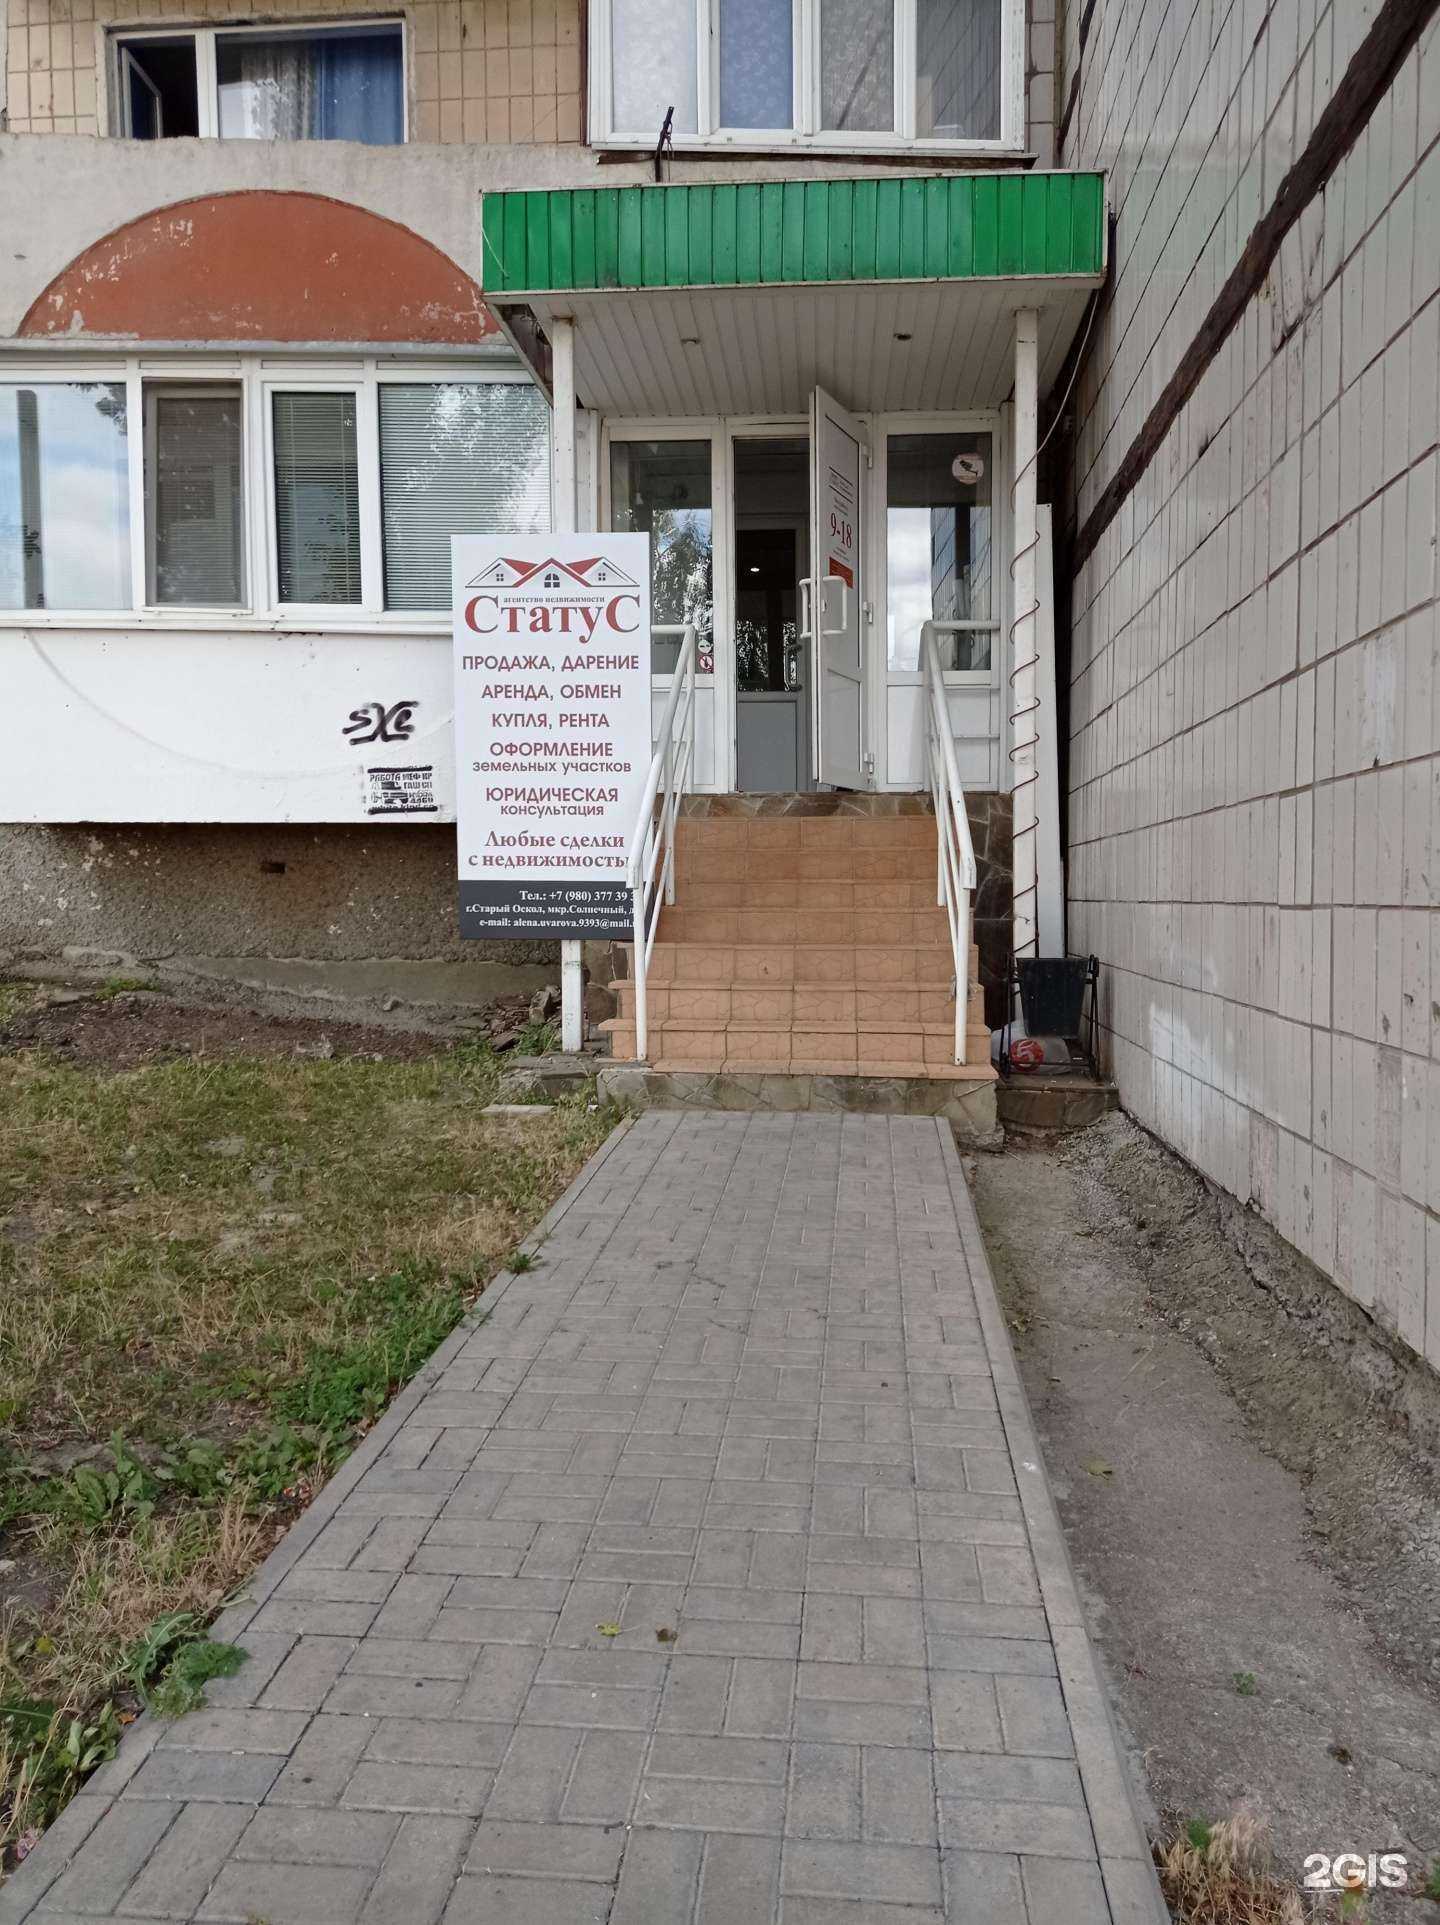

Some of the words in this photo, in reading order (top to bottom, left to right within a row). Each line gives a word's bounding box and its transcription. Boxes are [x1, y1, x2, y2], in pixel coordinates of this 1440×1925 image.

[830, 512, 852, 549] 9-18
[464, 594, 640, 644] СтатуС
[462, 656, 555, 671] ПРОДАЖА,
[561, 656, 639, 671] ДАРЕНИЕ
[481, 685, 554, 701] АРЕНДА,
[560, 684, 621, 699] ОБМЕН
[491, 713, 552, 730] КУПЛЯ,
[559, 713, 610, 727] РЕНТА
[489, 742, 613, 757] ОФОРМЛЕНИЕ
[472, 760, 556, 773] земельных
[562, 761, 632, 775] участков
[369, 773, 401, 782] РАБОТА
[486, 787, 619, 804] ЮРИДИЧЕСКАЯ
[500, 804, 605, 819] консультация
[485, 830, 555, 848] Любые
[560, 836, 625, 849] сделки
[468, 855, 478, 866] с
[482, 855, 629, 869] недвижимость
[519, 890, 547, 901] Тел.:
[549, 891, 562, 901] +7
[565, 890, 592, 902] (980)
[594, 891, 612, 901] 377
[615, 891, 628, 901] 39
[465, 904, 510, 915] г.Старый
[512, 904, 546, 914] Оскол,
[547, 904, 627, 915] мкр.Солнечный,
[479, 918, 512, 927] e-mail:
[513, 918, 634, 929] alena.uvarova.9393@mail.
